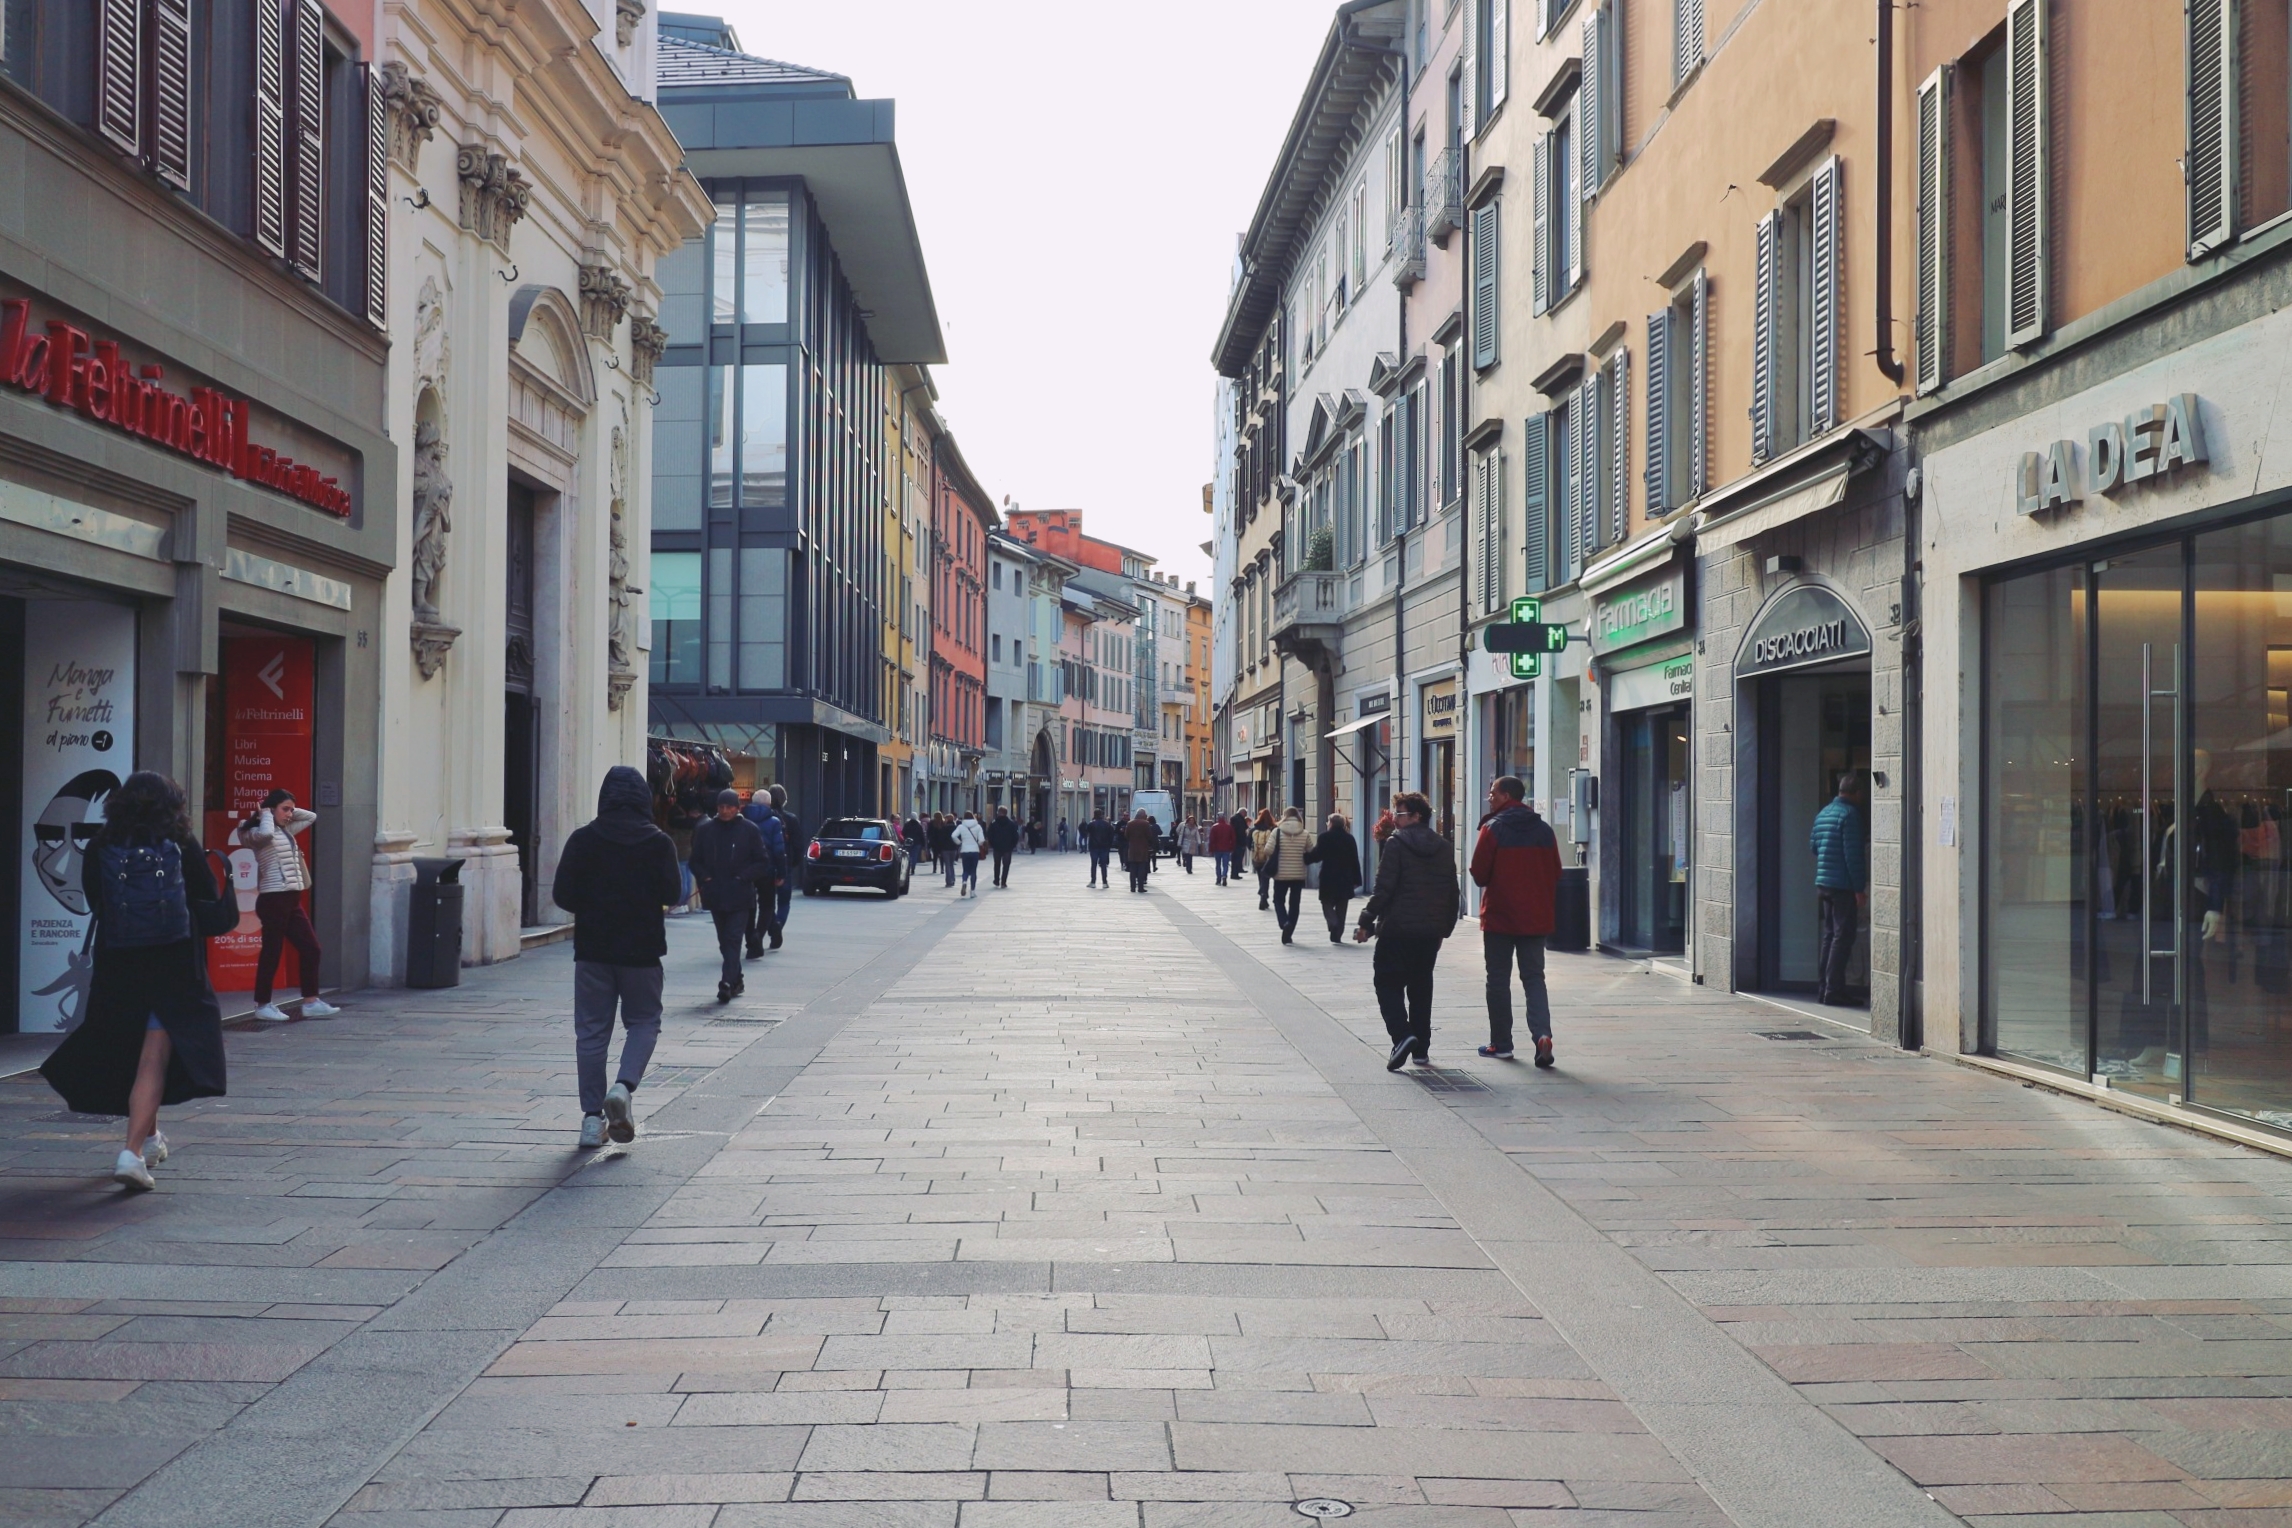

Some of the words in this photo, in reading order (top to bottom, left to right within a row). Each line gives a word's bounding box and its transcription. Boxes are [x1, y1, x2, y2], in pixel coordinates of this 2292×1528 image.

[2017, 440, 2083, 516] LA
[2088, 393, 2209, 495] DEA
[357, 630, 368, 648] 55
[1755, 620, 1844, 663] DISCACCIATI
[47, 661, 115, 696] Manga
[75, 688, 83, 700] e
[46, 694, 114, 723] Fumetti
[46, 730, 59, 747] al
[58, 733, 89, 753] piano
[234, 739, 257, 750] Libri
[234, 755, 271, 766] Musica
[234, 770, 272, 781] Cinema
[233, 787, 270, 799] Manga
[31, 919, 73, 928] PAZIENZA
[31, 930, 37, 938] E
[40, 930, 81, 938] RANCORE
[214, 936, 236, 944] 20%
[237, 935, 247, 943] di
